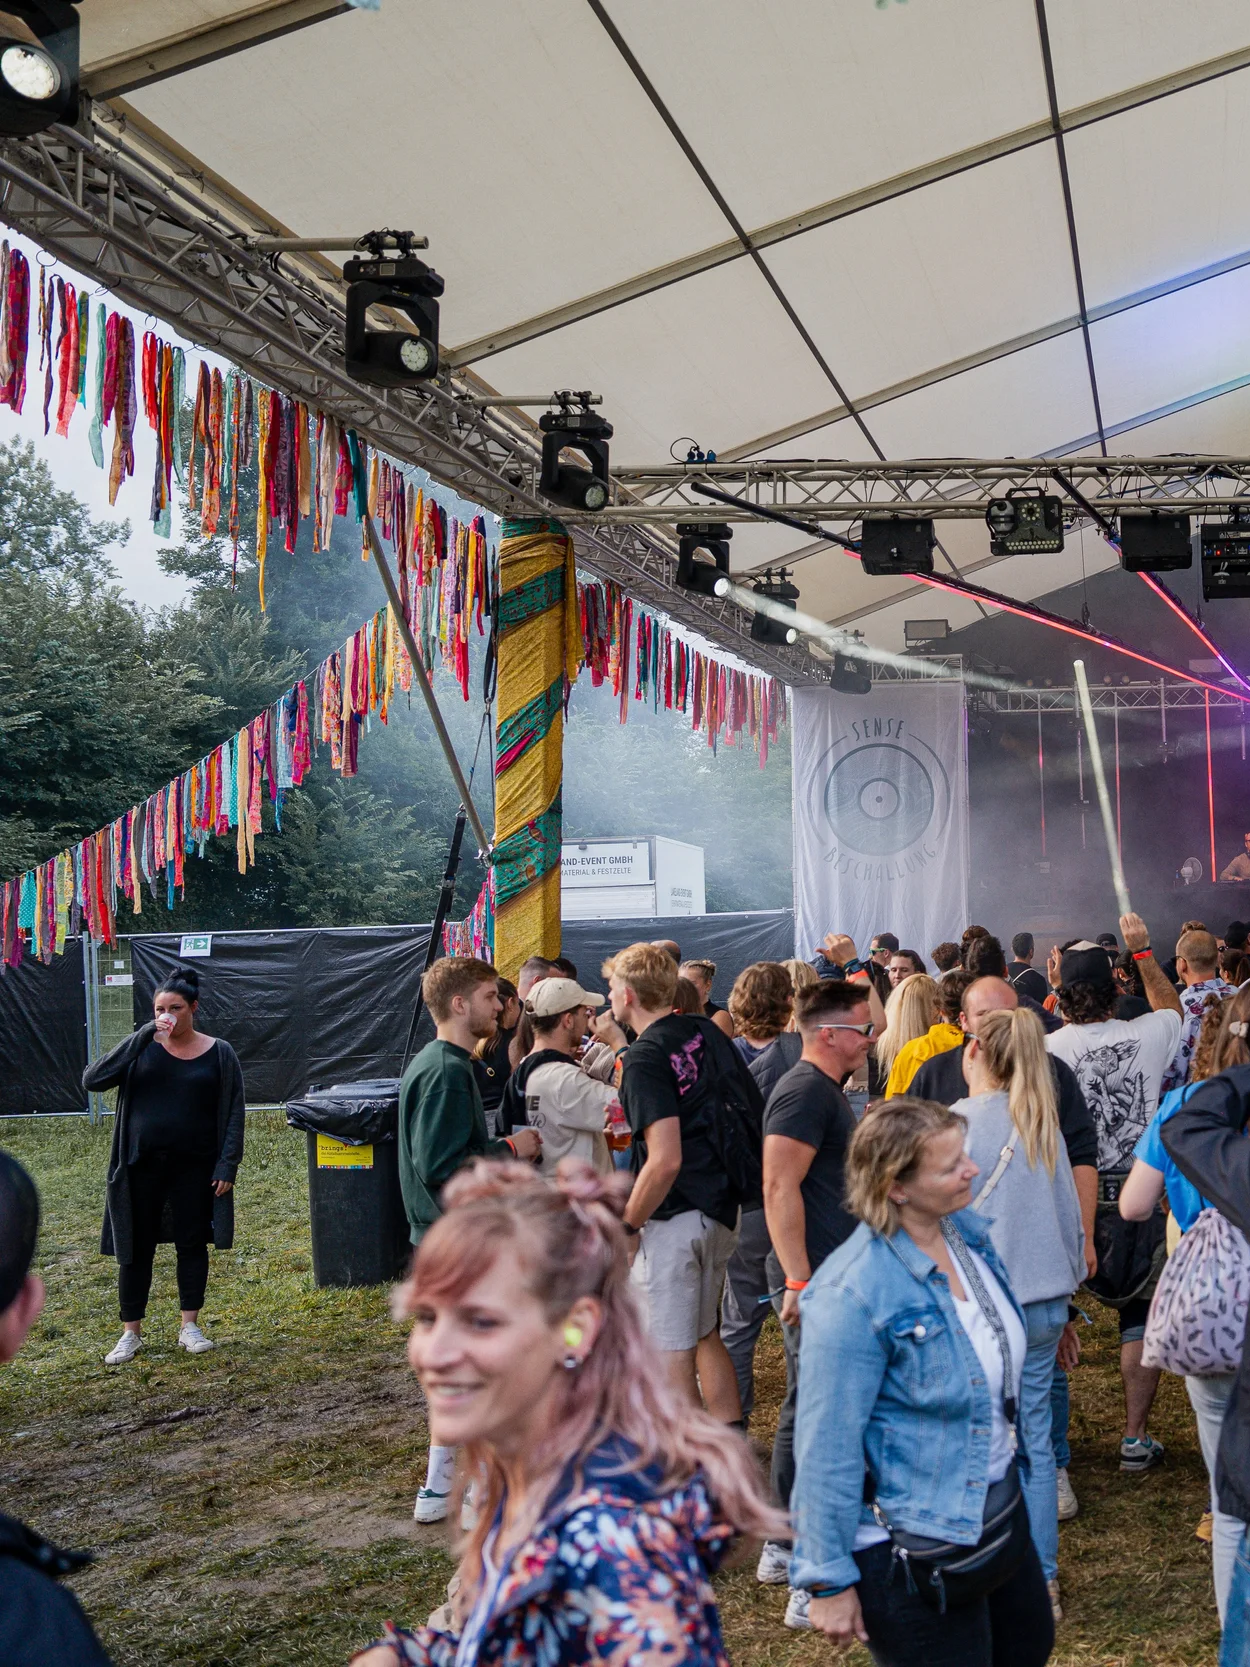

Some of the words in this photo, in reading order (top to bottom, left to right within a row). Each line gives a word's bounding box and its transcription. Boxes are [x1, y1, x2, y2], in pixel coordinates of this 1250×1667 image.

[851, 717, 905, 742] SENSE
[608, 855, 634, 864] GMBH
[823, 843, 937, 882] BESCHALLUNG
[597, 867, 632, 875] FESTZELTE
